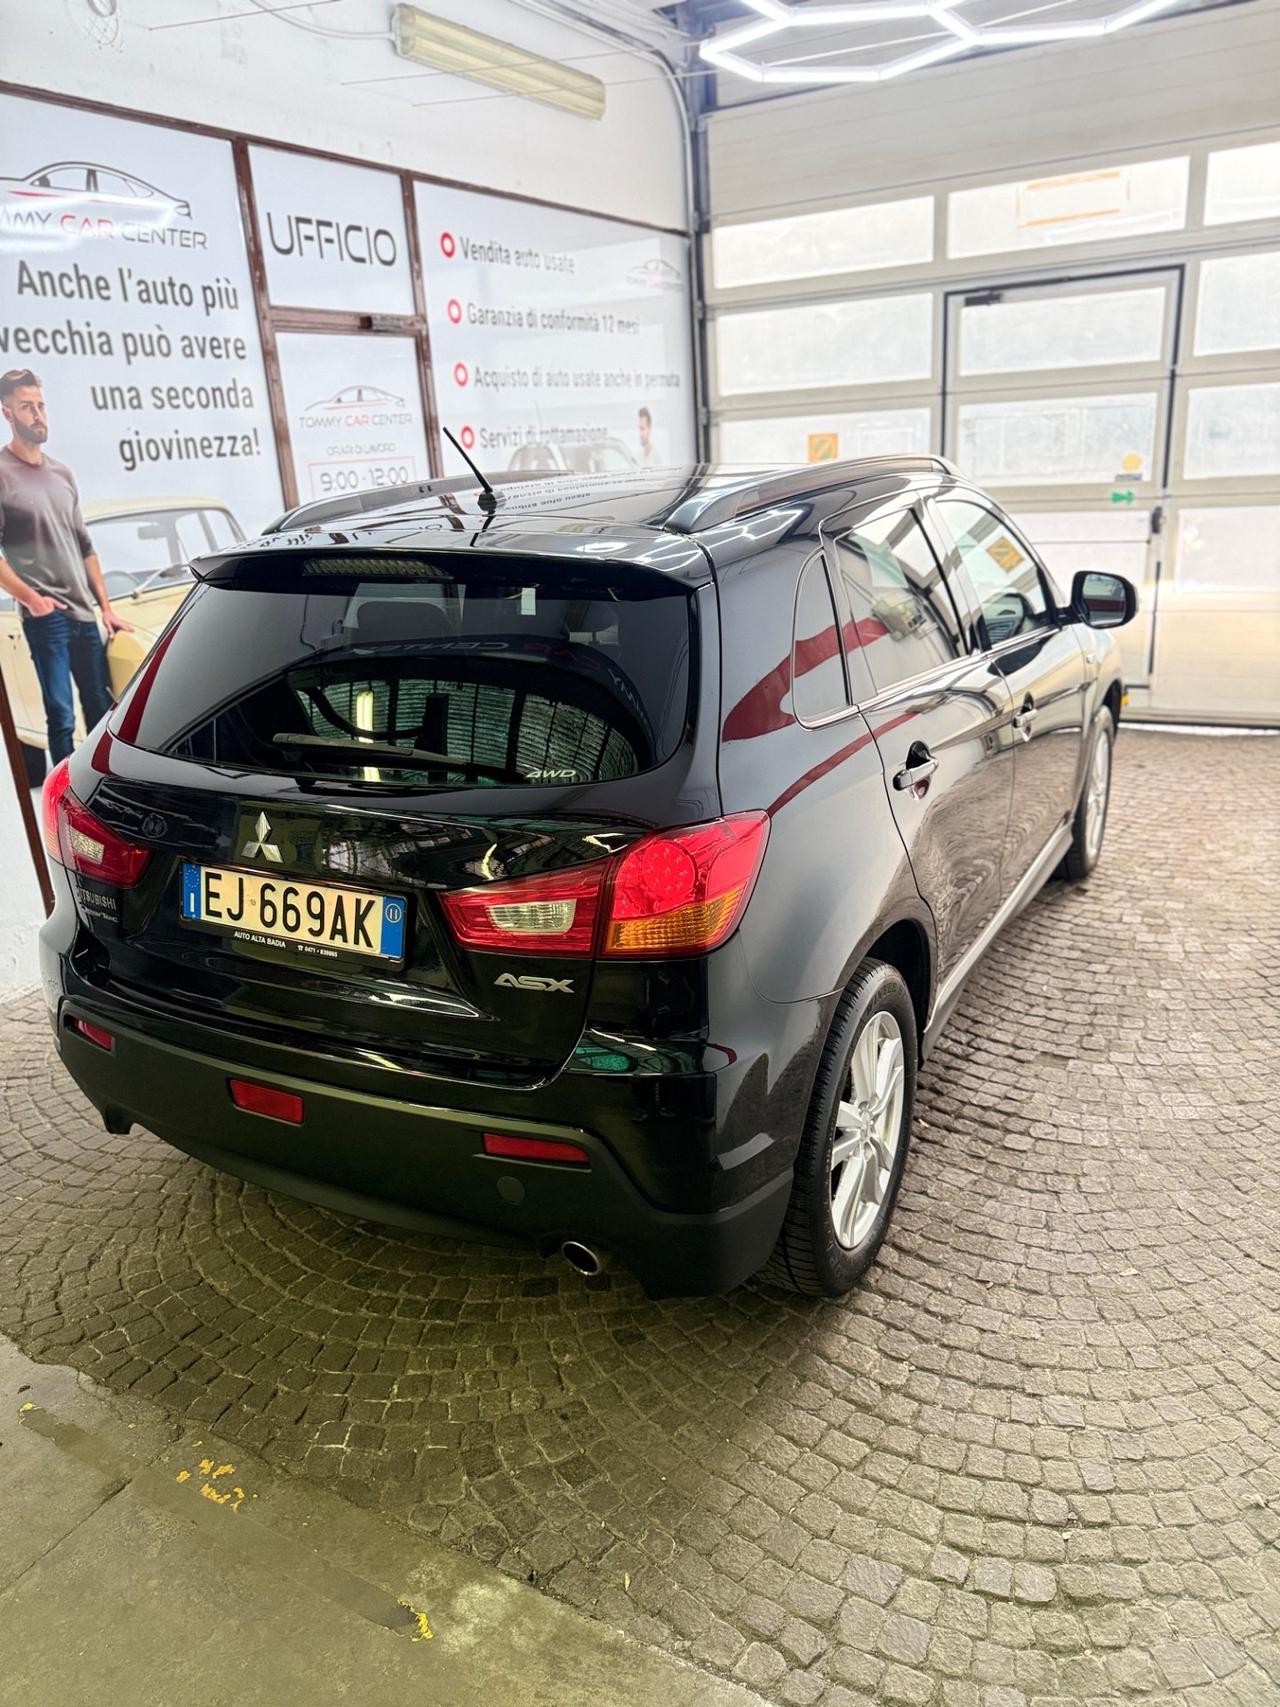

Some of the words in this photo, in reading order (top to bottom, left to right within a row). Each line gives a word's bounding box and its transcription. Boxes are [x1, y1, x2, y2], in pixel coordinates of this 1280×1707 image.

[60, 214, 114, 239] CAR
[121, 221, 208, 250] CENTER
[266, 211, 398, 267] UFFICIO
[459, 236, 511, 265] Vendita
[514, 248, 541, 269] auto
[544, 254, 576, 275] usate
[17, 259, 112, 301] Anche
[201, 277, 240, 317] più
[466, 302, 523, 328] Garanzia
[526, 306, 538, 329] di
[540, 309, 600, 333] conformità
[602, 315, 615, 334] 12
[617, 316, 640, 335] mesi
[0, 319, 114, 357] vecchia
[122, 324, 172, 366] può
[180, 333, 247, 360] avere
[90, 384, 143, 411] una
[151, 378, 254, 410] seconda
[473, 366, 529, 395] Acquisto
[532, 366, 543, 388] di
[546, 369, 570, 389] auto
[572, 371, 601, 389] usate
[299, 416, 343, 429] TOMMY
[345, 414, 370, 427] CAR
[372, 412, 413, 426] CENTER
[479, 425, 523, 449] Servizi
[119, 427, 261, 472] giovinezza!
[526, 769, 577, 779] 4WD
[204, 871, 245, 921] EJ
[259, 882, 376, 949] 669AK
[234, 930, 251, 941] AUTO
[251, 934, 266, 945] ALTA
[267, 938, 286, 948] BADIA
[493, 972, 575, 994] ASX
